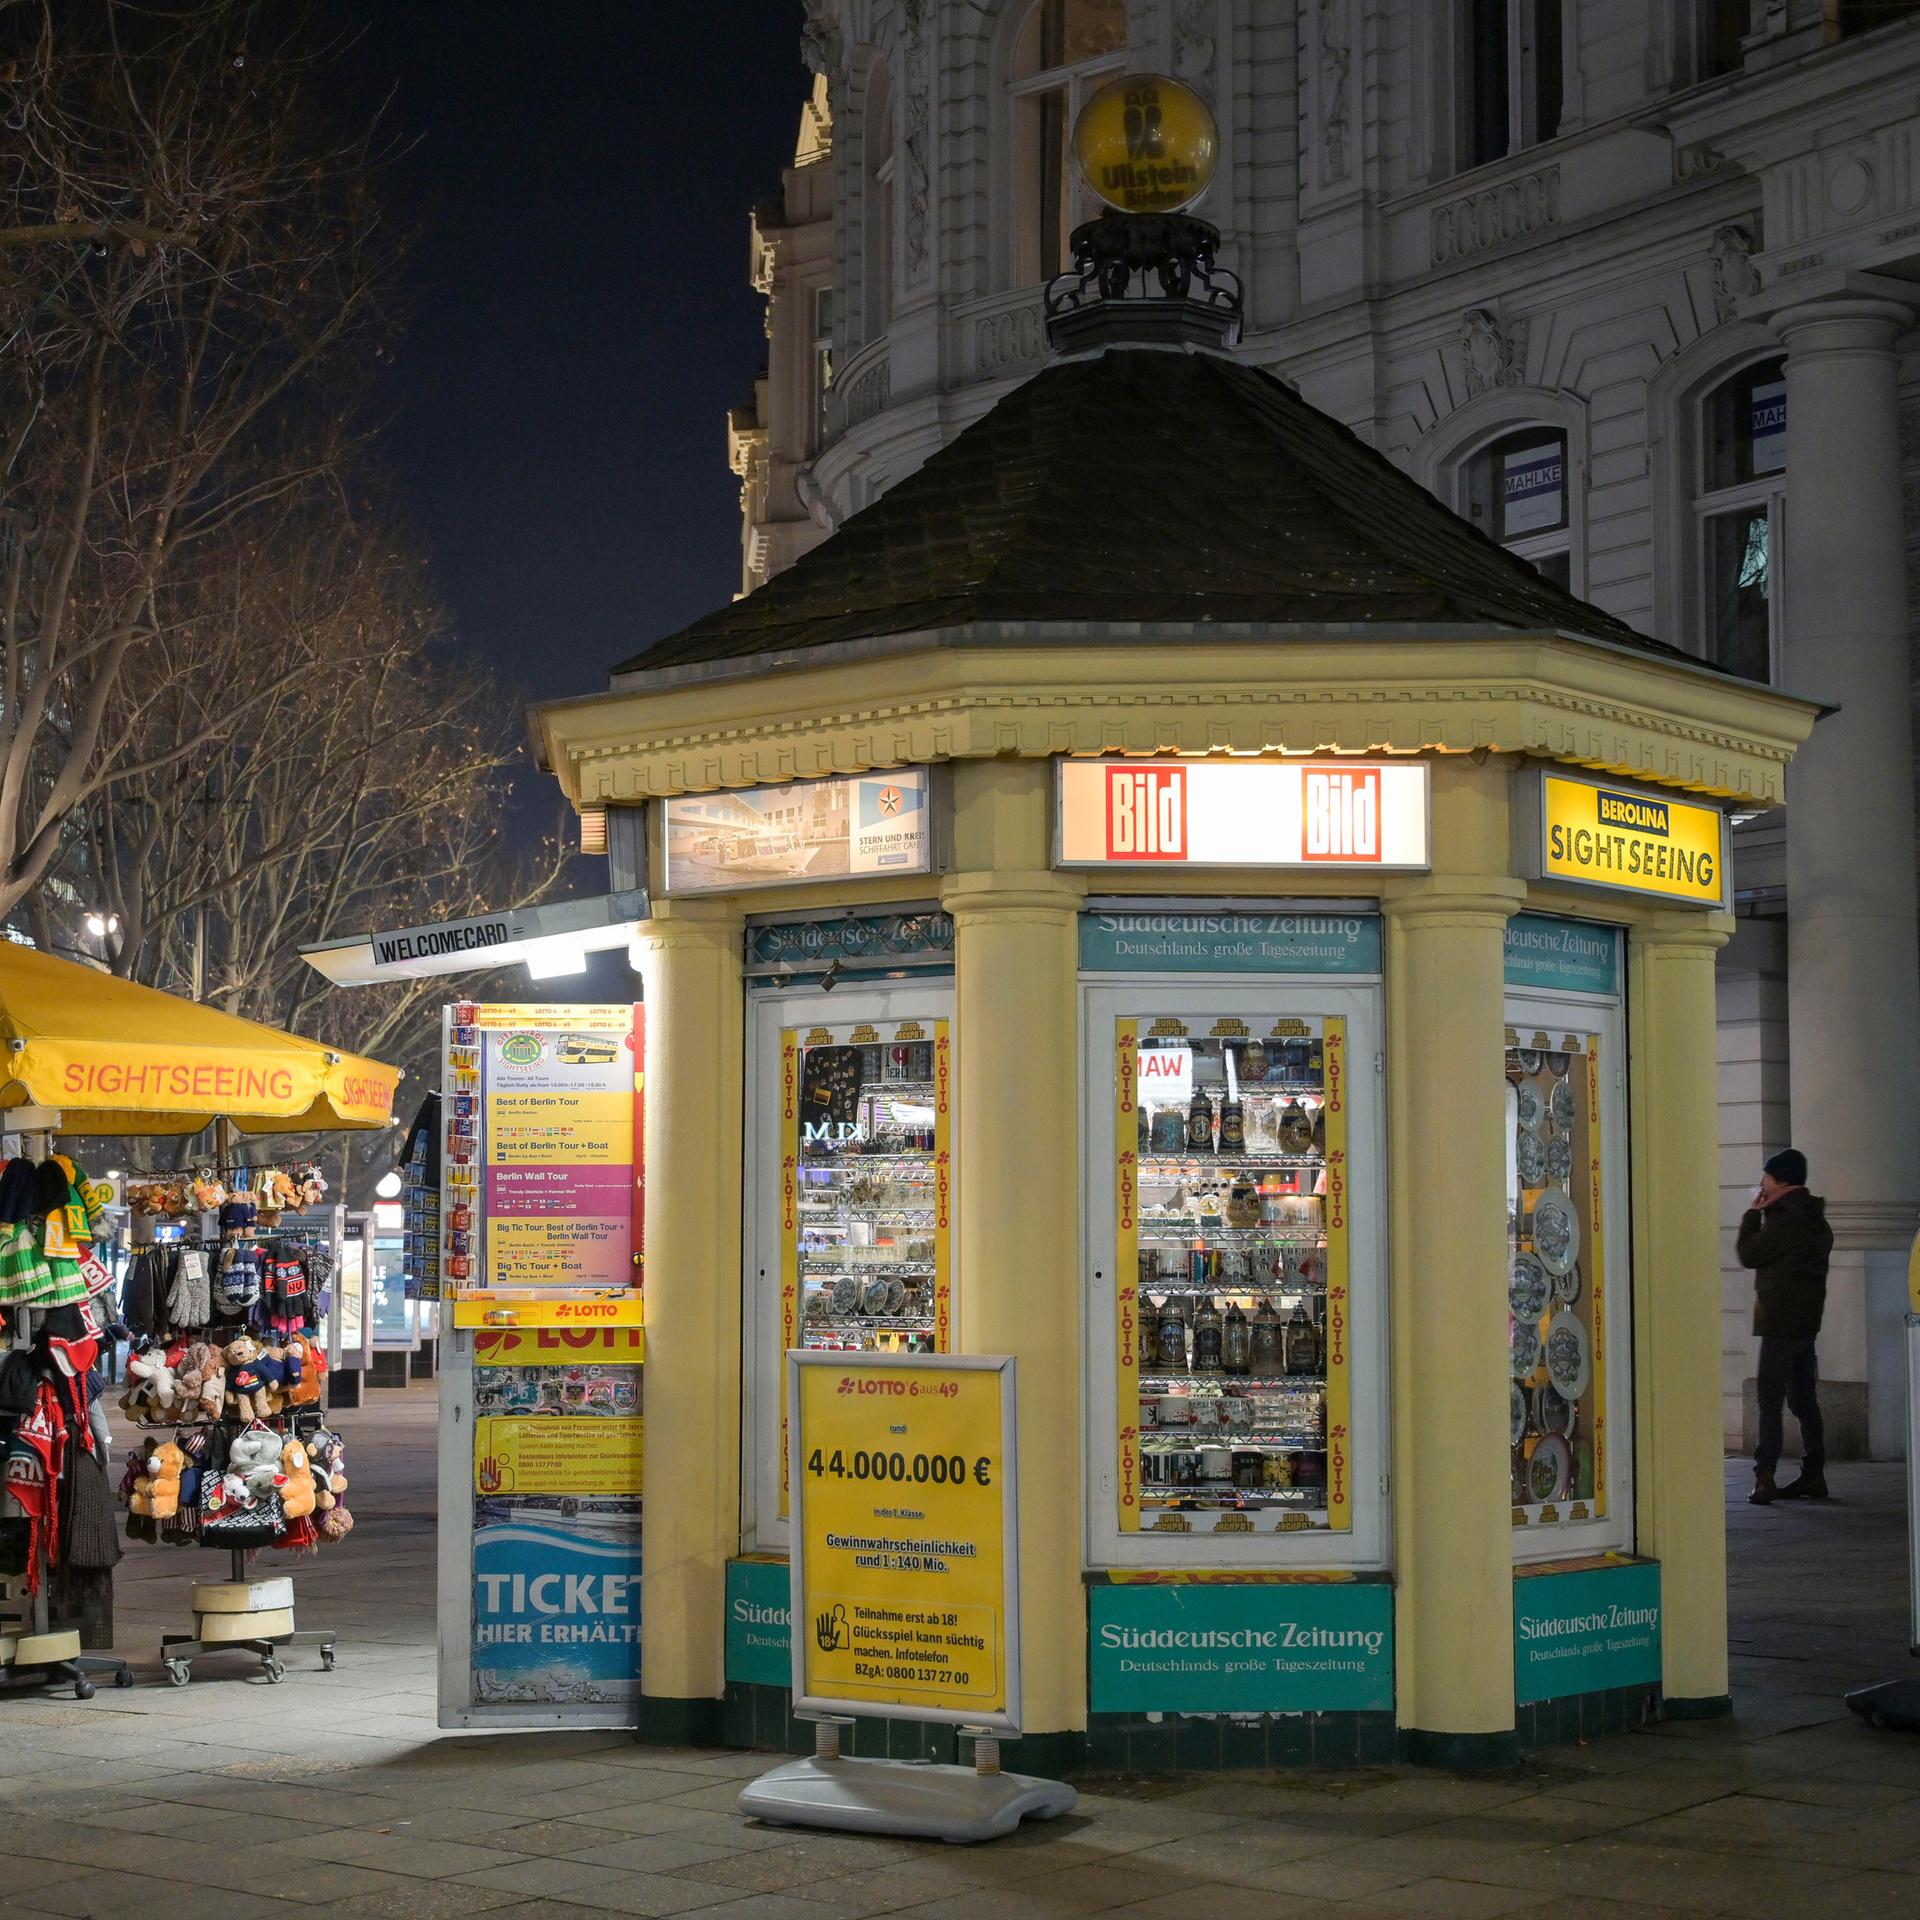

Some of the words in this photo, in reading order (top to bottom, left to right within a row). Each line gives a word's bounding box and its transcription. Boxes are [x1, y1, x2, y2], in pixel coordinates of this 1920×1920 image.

[1102, 158, 1198, 190] Ullstein
[1753, 405, 1787, 428] MAH
[1506, 466, 1561, 492] MAHLKE
[1112, 773, 1182, 854] Bild
[1307, 774, 1376, 855] Bild
[1601, 798, 1668, 831] BEROLINA
[859, 836, 883, 846] STERN
[885, 834, 902, 843] UND
[1550, 824, 1714, 887] SIGHTSEEING
[380, 923, 508, 963] WELCOMECARD
[1115, 940, 1209, 955] Deutschlands
[1258, 942, 1345, 958] Tageszeitung
[1561, 929, 1609, 965] Zeitung
[1148, 1026, 1189, 1036] JACKPOT
[1210, 1026, 1250, 1036] JACKPOT
[1270, 1026, 1311, 1036] JACKPOT
[497, 1057, 546, 1073] SIGHTSEEING
[63, 1063, 293, 1100] SIGHTSEEING
[785, 1062, 793, 1120] LOTTO
[939, 1055, 948, 1115] LOTTO
[1121, 1053, 1132, 1113] LOTTO
[1329, 1052, 1341, 1113] LOTTO
[496, 1098, 517, 1106] Best
[519, 1098, 529, 1106] of
[530, 1098, 556, 1106] Berlin
[559, 1098, 579, 1106] Tour
[496, 1142, 517, 1150] Best
[519, 1142, 529, 1150] of
[530, 1142, 556, 1150] Berlin
[559, 1142, 579, 1150] Tour
[587, 1142, 609, 1150] Boat
[496, 1173, 523, 1181] Berlin
[525, 1173, 545, 1181] Wall
[547, 1173, 568, 1181] Tour
[785, 1173, 793, 1230] LOTTO
[939, 1170, 948, 1229] LOTTO
[1121, 1169, 1132, 1230] LOTTO
[1332, 1168, 1343, 1229] LOTTO
[497, 1223, 510, 1233] Big
[511, 1223, 524, 1231] Tic
[525, 1223, 545, 1231] Tour:
[546, 1223, 564, 1231] Best
[566, 1223, 574, 1231] of
[575, 1223, 598, 1231] Berlin
[600, 1223, 617, 1231] Tour
[547, 1232, 569, 1240] Berlin
[571, 1232, 589, 1240] Wall
[590, 1232, 608, 1240] Tour
[497, 1262, 512, 1272] Big
[515, 1262, 527, 1270] Tic
[529, 1262, 551, 1270] Tour
[561, 1262, 582, 1270] Boat
[574, 1305, 618, 1317] LOTTO
[1122, 1305, 1133, 1367] LOTTO
[1332, 1304, 1344, 1365] LOTTO
[858, 1379, 906, 1395] LOTTO
[808, 1449, 966, 1485] 44.000.000
[973, 1457, 991, 1486] €
[1123, 1444, 1134, 1506] LOTTO
[1333, 1443, 1345, 1505] LOTTO
[826, 1533, 976, 1556] Gewinnwahrscheinlichkeit
[855, 1554, 880, 1567] rund
[923, 1558, 948, 1572] Mio.
[733, 1599, 792, 1625] Südde
[854, 1606, 903, 1622] Teilnahme
[905, 1613, 925, 1624] erst
[927, 1613, 939, 1625] ab
[941, 1614, 958, 1627] 18!
[1519, 1613, 1608, 1640] Süddeutsche
[1608, 1604, 1658, 1631] Zeitung
[477, 1624, 532, 1643] HIER
[747, 1633, 792, 1648] Deutsch
[853, 1626, 913, 1643] Glücksspiel
[916, 1631, 942, 1644] kann
[945, 1634, 985, 1650] süchtig
[1100, 1623, 1277, 1649] Süddeutsche
[1279, 1622, 1384, 1655] Zeitung
[854, 1646, 893, 1660] machen.
[896, 1648, 949, 1663] Infotelefon
[1530, 1644, 1581, 1662] Deutschlands
[1605, 1636, 1650, 1653] Tageszeitung
[855, 1663, 885, 1679] BZgA:
[886, 1666, 916, 1680] 0800
[954, 1672, 969, 1684] 00
[1120, 1659, 1219, 1672] Deutschlands
[1225, 1659, 1266, 1673] große
[1272, 1658, 1366, 1673] Tageszeitung
